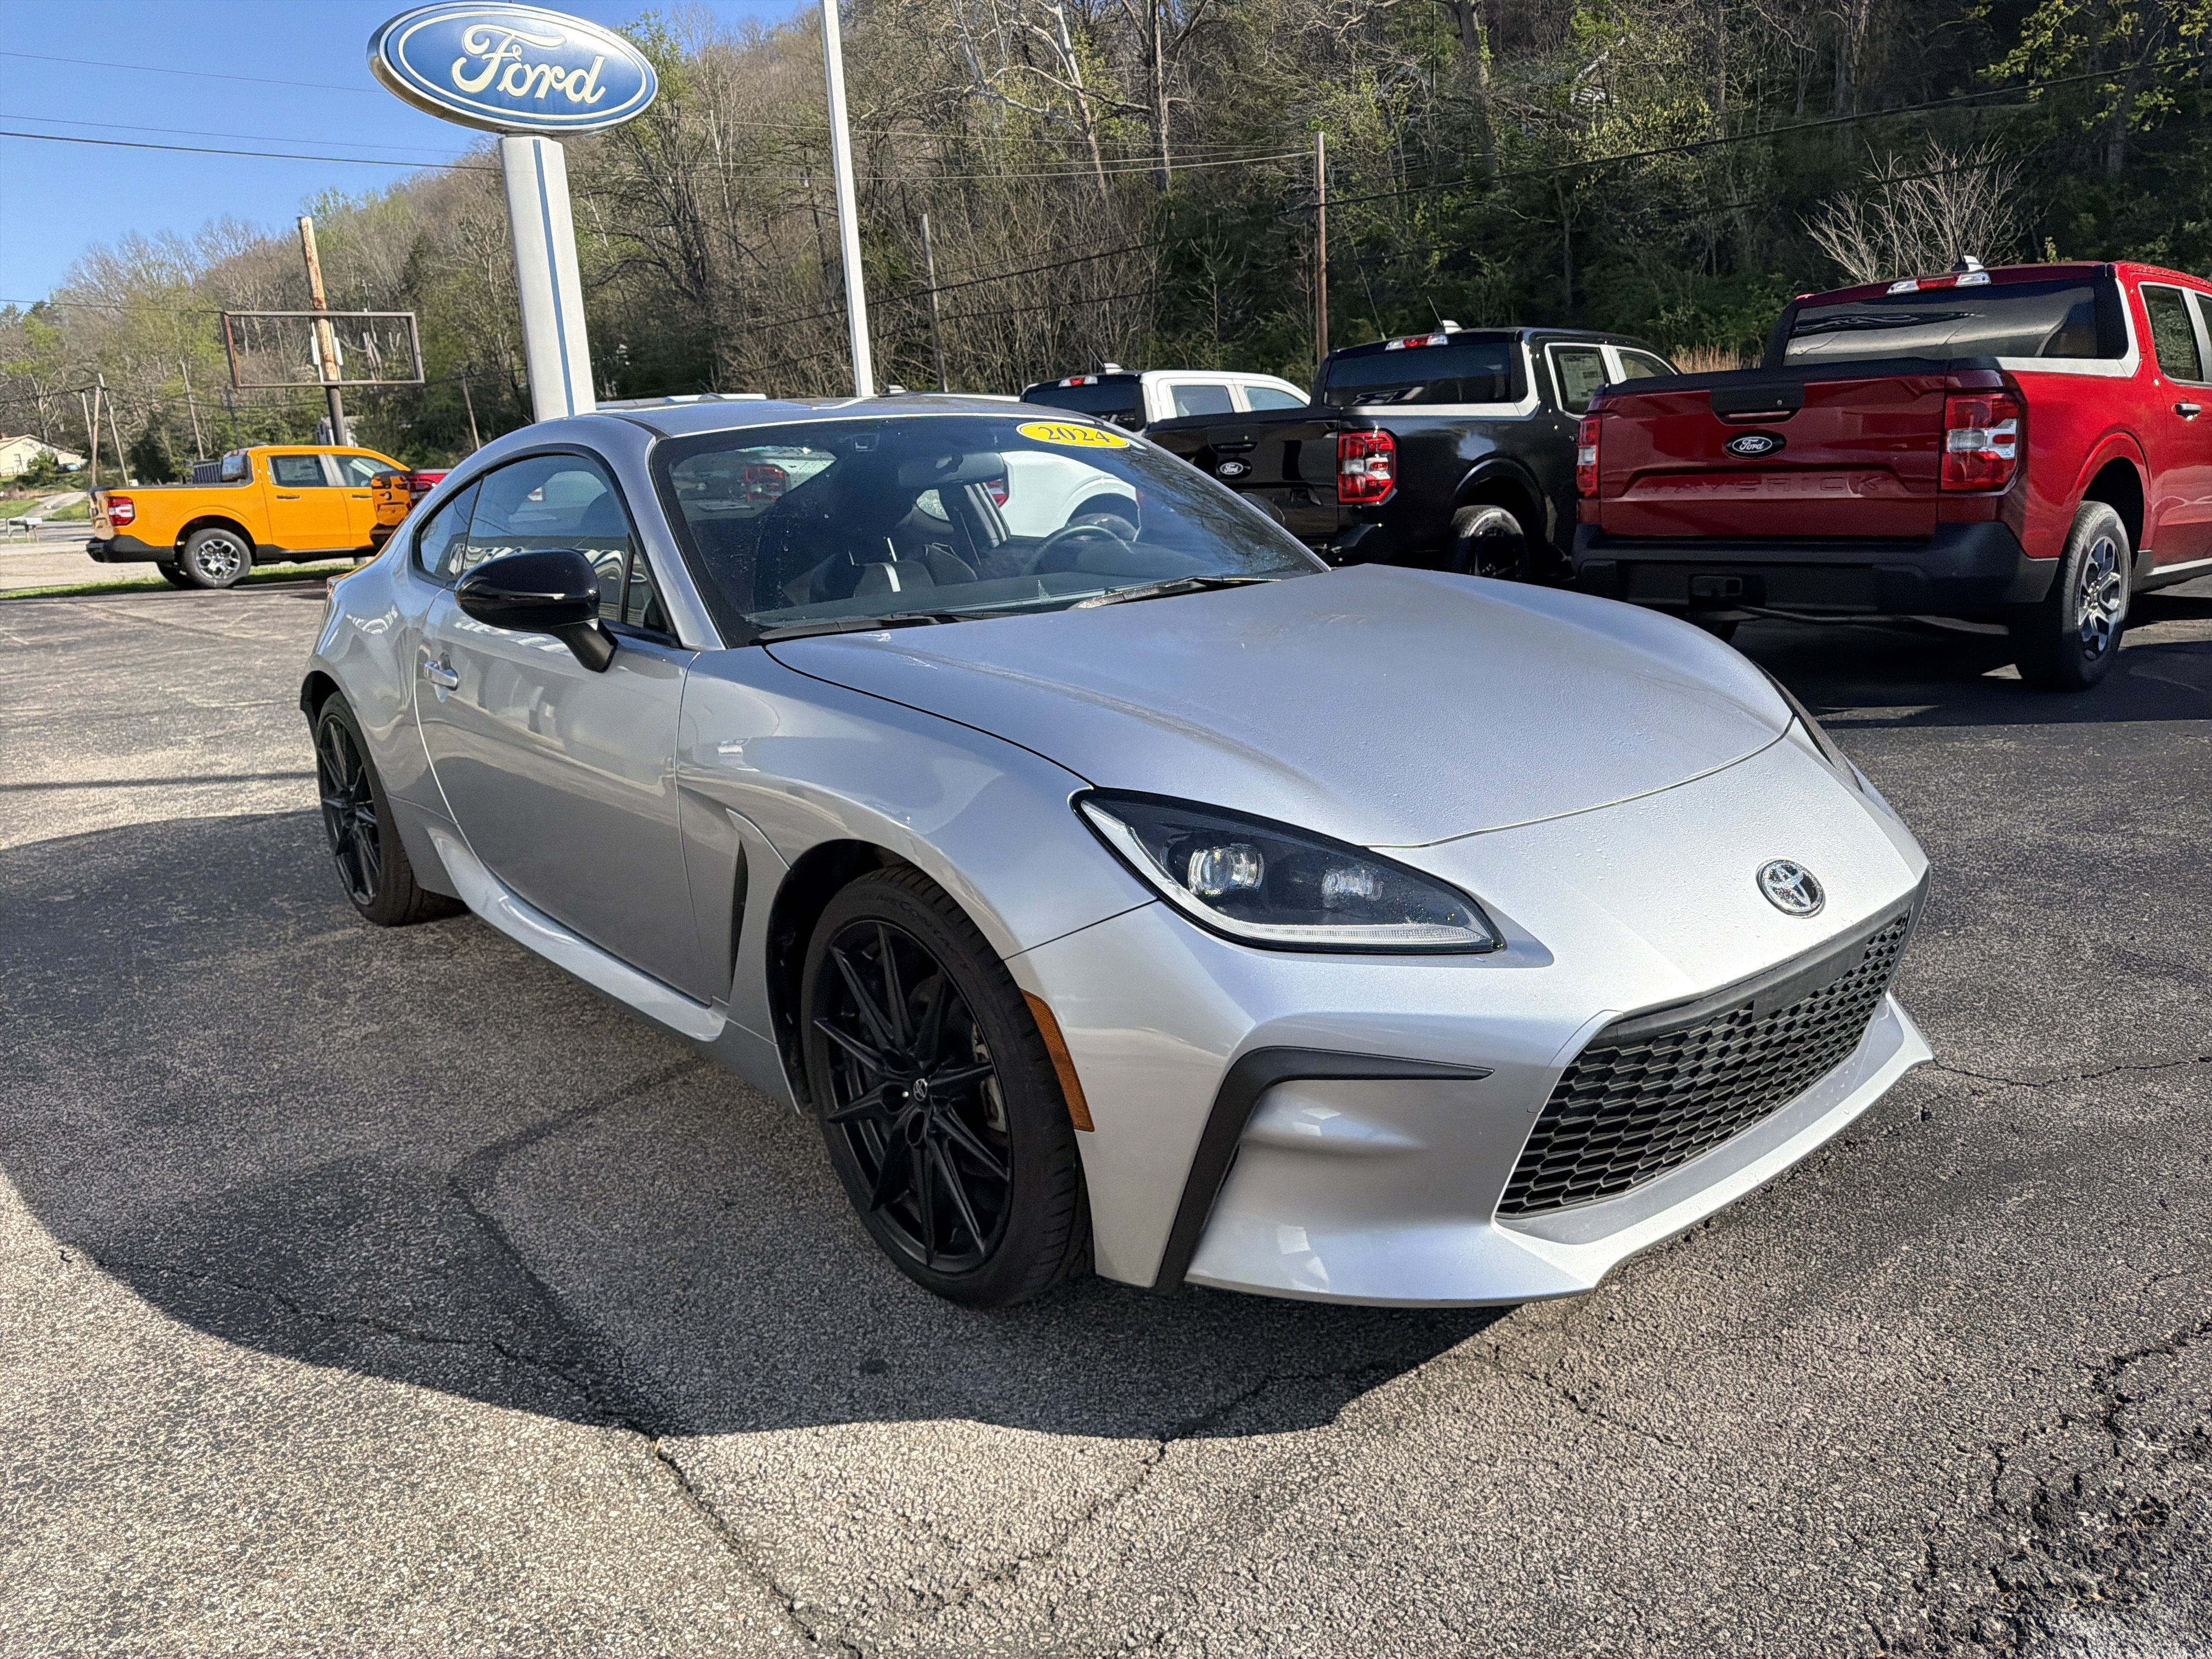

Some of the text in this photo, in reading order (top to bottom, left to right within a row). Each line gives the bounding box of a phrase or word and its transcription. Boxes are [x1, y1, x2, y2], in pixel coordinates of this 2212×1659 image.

[452, 24, 606, 104] Ford
[1038, 427, 1111, 443] 2024
[1739, 439, 1765, 450] Ford
[1224, 464, 1239, 472] Ford
[1643, 476, 1882, 494] MAVERICK
